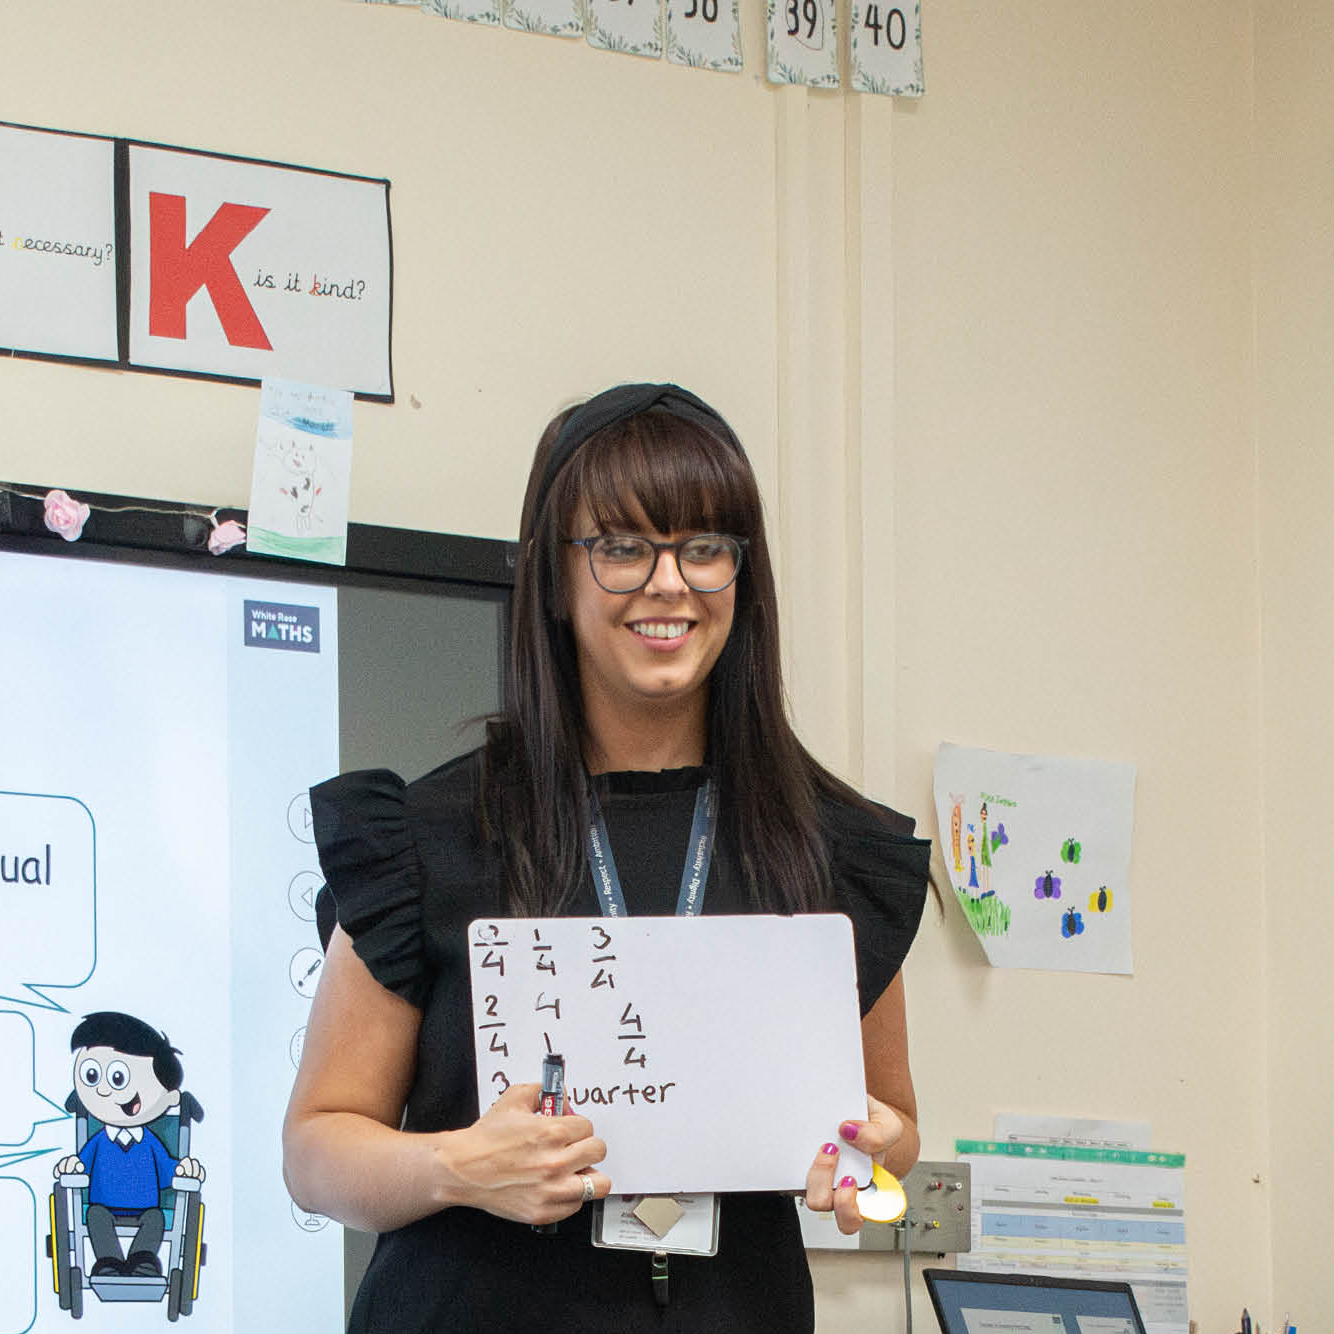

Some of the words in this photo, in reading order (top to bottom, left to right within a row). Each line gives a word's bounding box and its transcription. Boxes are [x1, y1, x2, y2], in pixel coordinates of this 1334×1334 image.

[864, 0, 907, 50] 40
[148, 191, 274, 351] K
[253, 269, 277, 291] is
[283, 271, 304, 293] it
[310, 272, 368, 302] kind?
[251, 608, 277, 622] White
[278, 612, 298, 624] Rose
[251, 620, 314, 644] MATHS
[591, 926, 612, 949] 3
[481, 950, 505, 977] 4
[535, 953, 557, 977] 4
[590, 969, 615, 990] 4
[485, 994, 499, 1017] 2
[619, 1003, 643, 1033] 4
[489, 1033, 509, 1058] 4
[623, 1047, 647, 1069] 4
[567, 1082, 676, 1107] uarter
